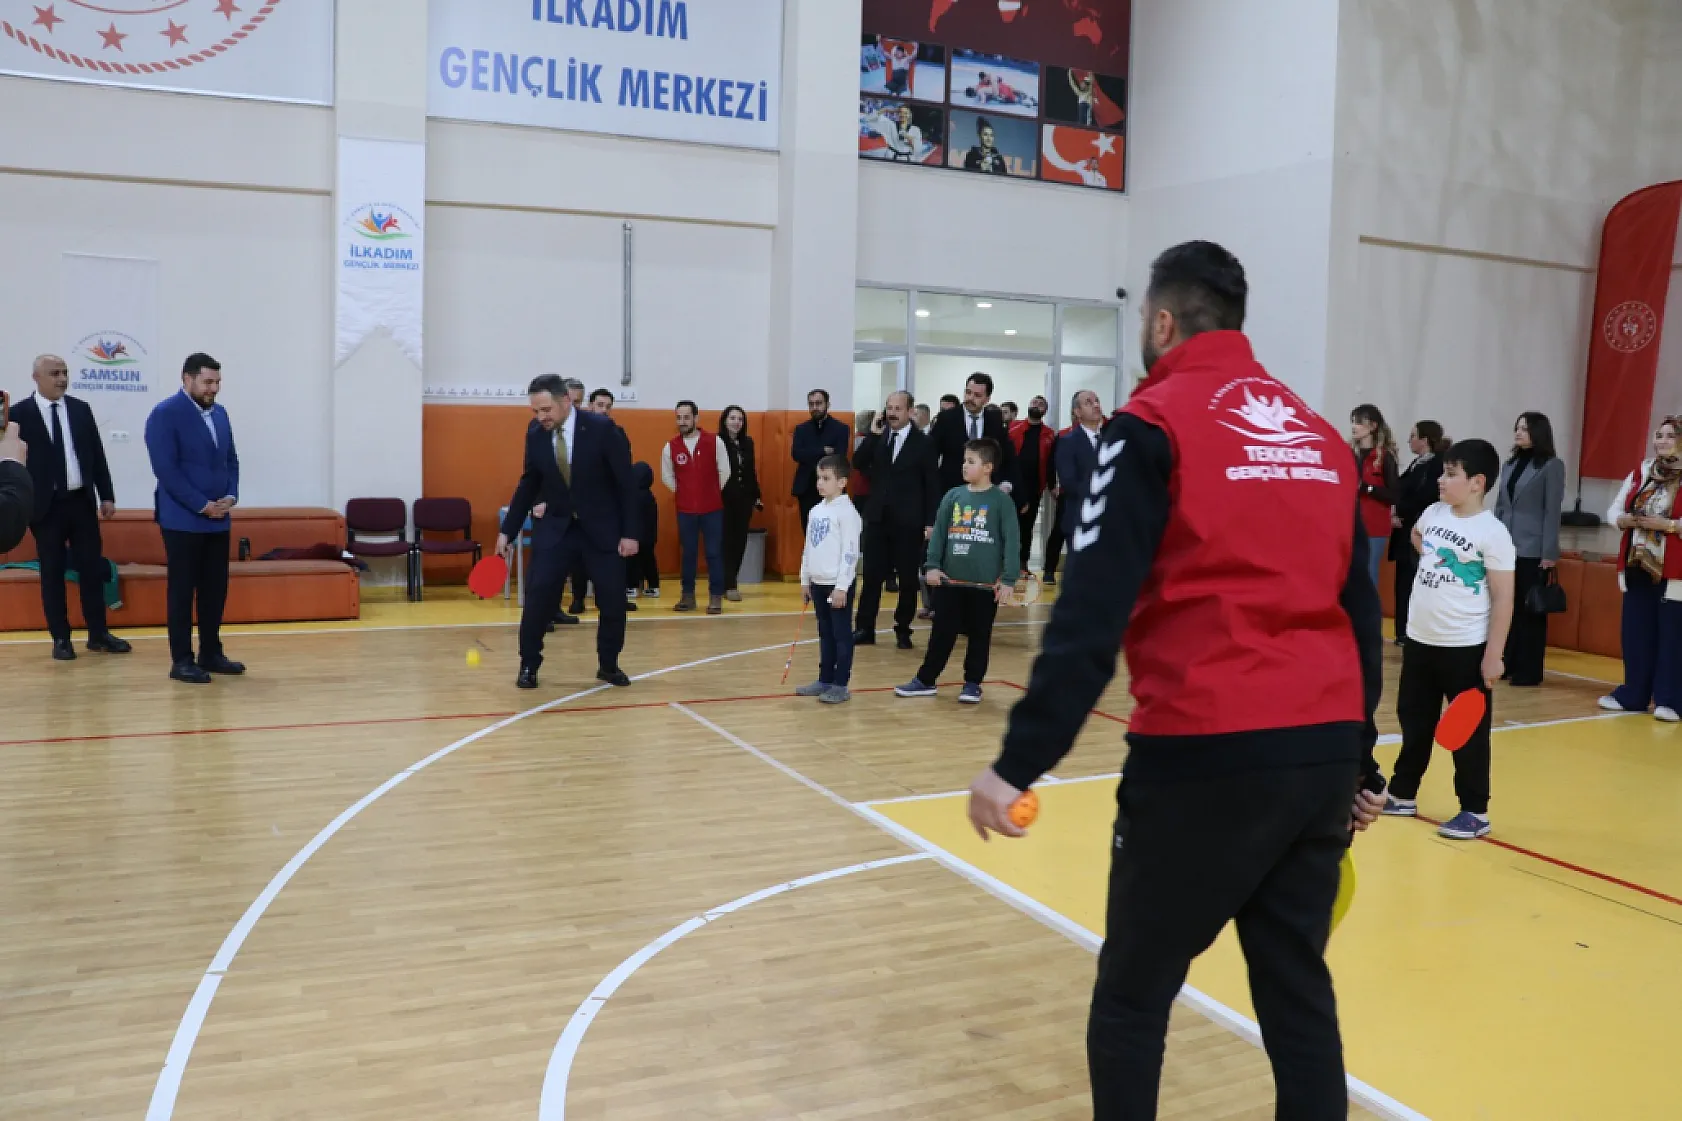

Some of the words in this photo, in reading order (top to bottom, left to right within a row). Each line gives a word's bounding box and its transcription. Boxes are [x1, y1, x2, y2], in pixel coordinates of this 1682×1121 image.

[440, 47, 602, 103] GENÇLİK
[618, 67, 767, 121] MERKEZİ
[350, 243, 412, 260] İLKADIM
[81, 368, 140, 381] SAMSUN
